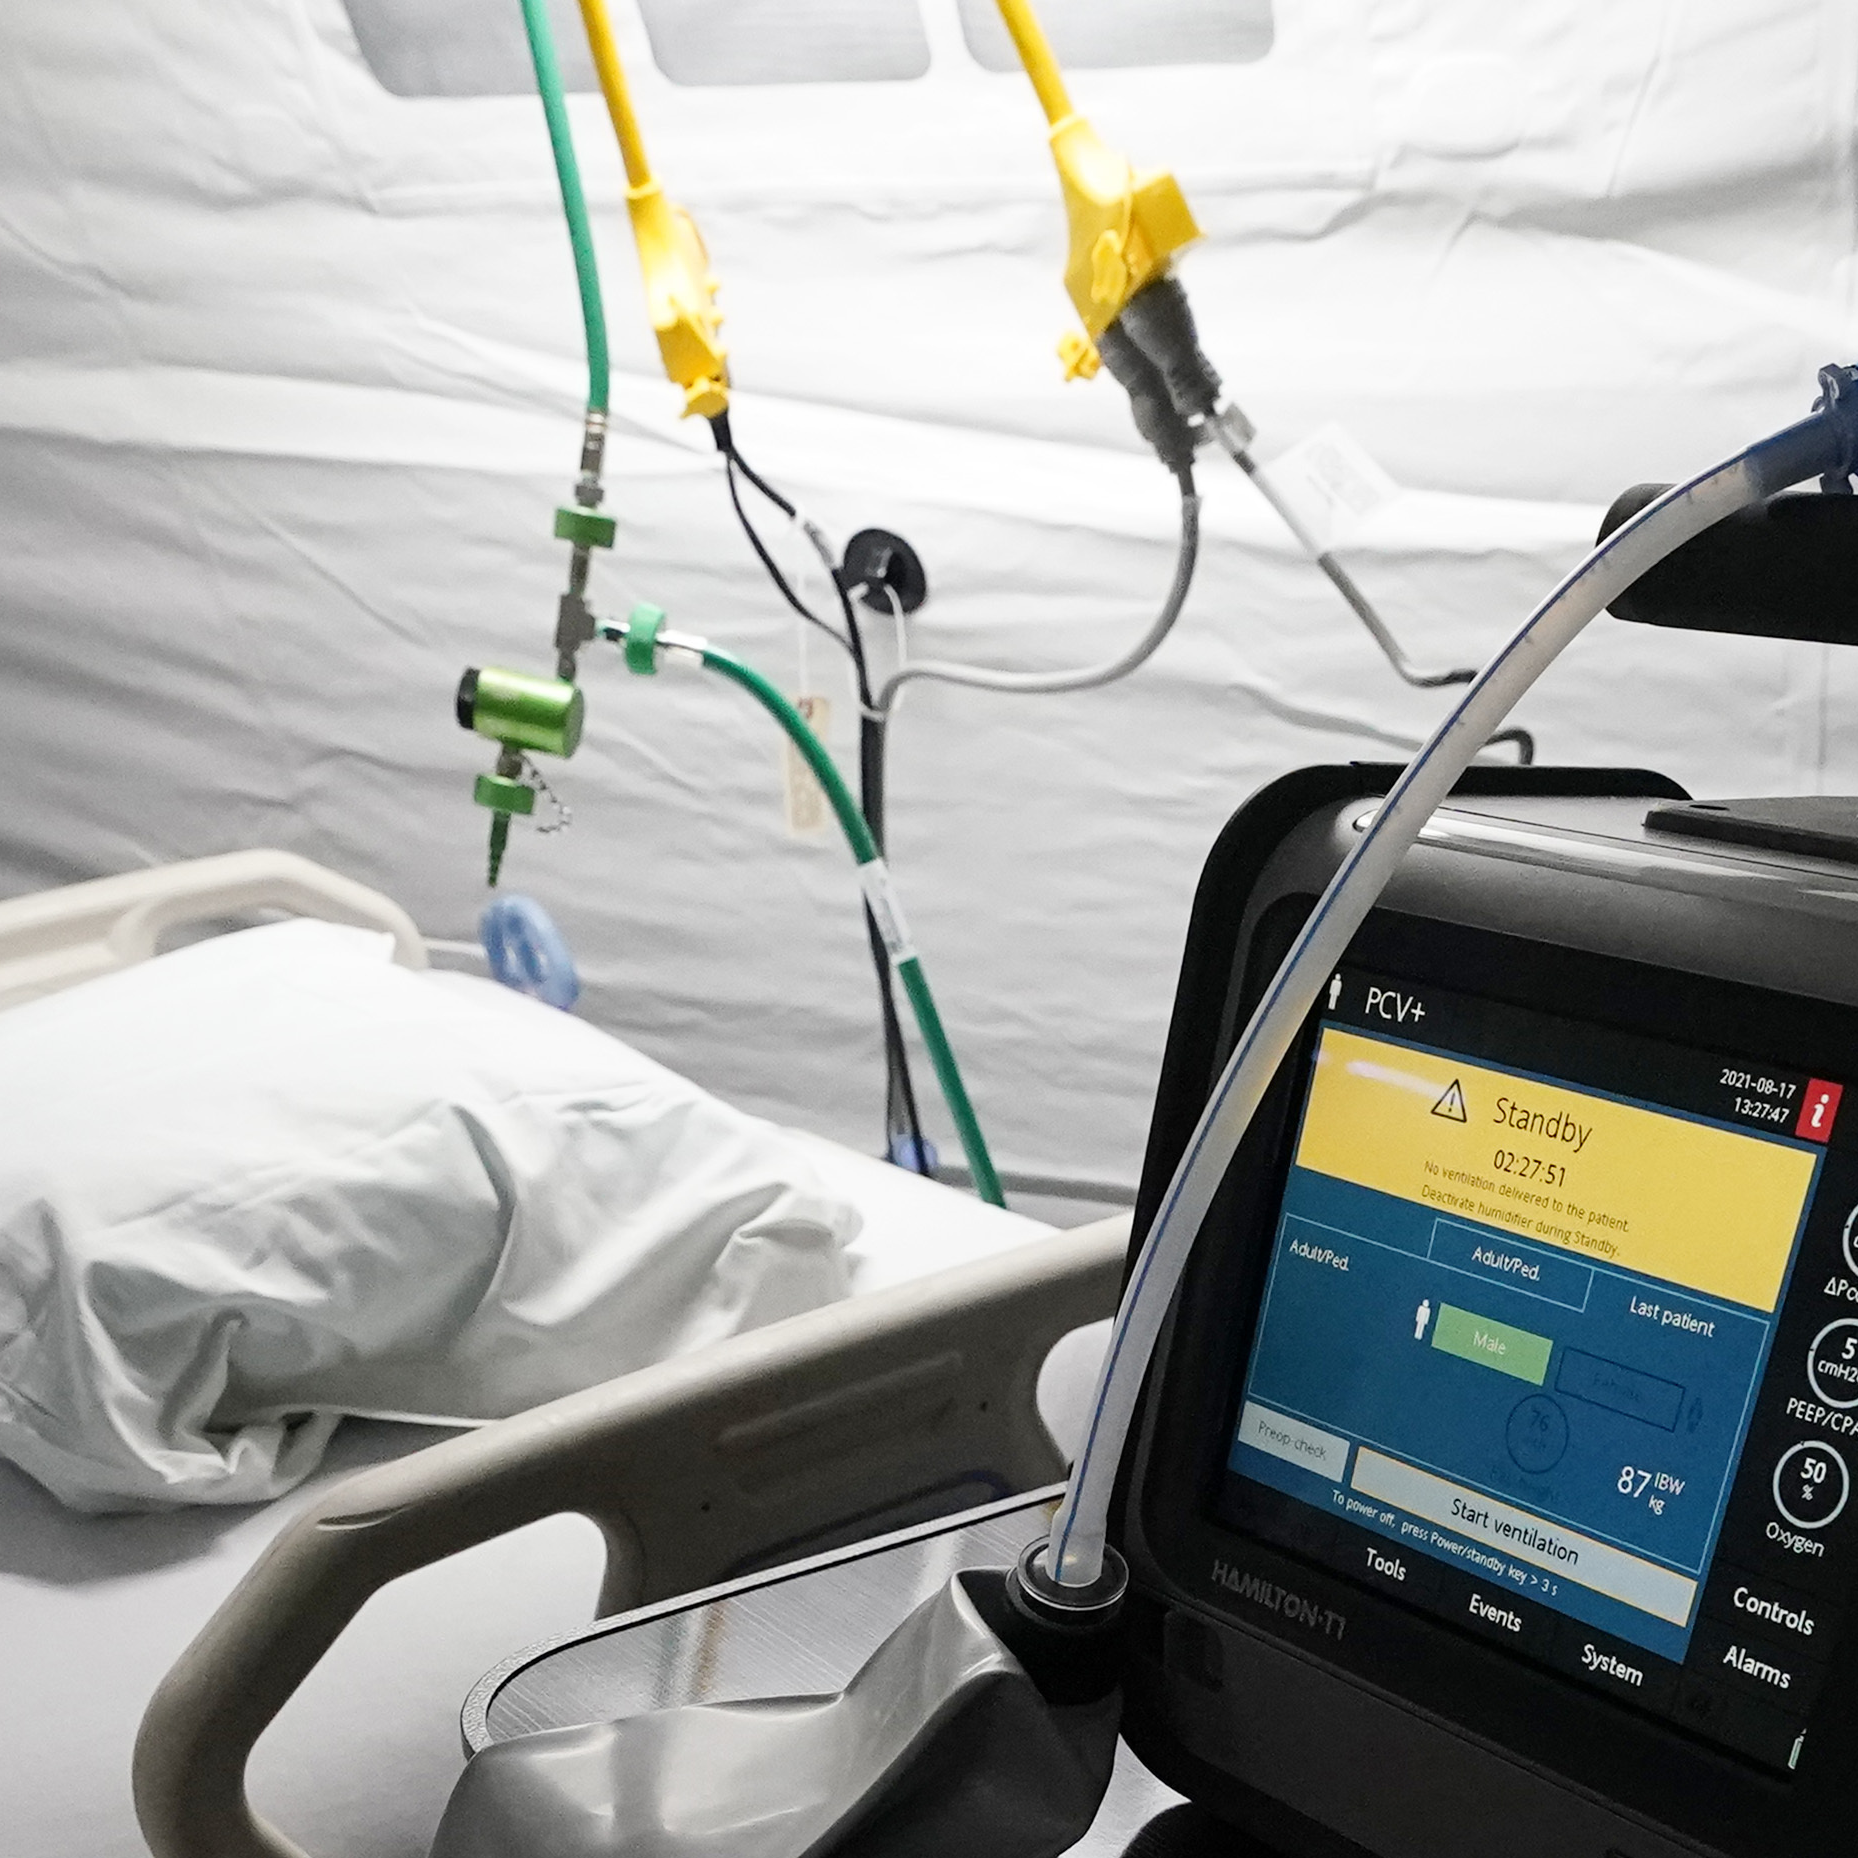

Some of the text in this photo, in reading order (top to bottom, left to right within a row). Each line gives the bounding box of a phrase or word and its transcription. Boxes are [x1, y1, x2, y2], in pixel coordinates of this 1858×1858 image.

[1364, 986, 1426, 1022] PCV+
[1720, 1068, 1797, 1099] 2021-08-17
[1493, 1097, 1593, 1153] Standby
[1735, 1096, 1790, 1124] 13:27:47
[1493, 1149, 1566, 1187] 02:27:51
[1424, 1160, 1439, 1175] No
[1442, 1167, 1495, 1193] ventilation
[1499, 1183, 1549, 1209] delivered
[1552, 1199, 1563, 1213] to
[1566, 1203, 1585, 1220] the
[1421, 1184, 1621, 1260] Deactivate humidifier during Standby.
[1289, 1238, 1349, 1271] Adult/Ped.
[1471, 1246, 1541, 1281] Adult/Ped.
[1629, 1295, 1716, 1338] Last patient
[1473, 1331, 1506, 1356] Male
[1841, 1337, 1858, 1360] 5
[1258, 1420, 1327, 1461] Preop check
[1617, 1465, 1686, 1499] 87 IBW
[1800, 1457, 1827, 1484] 50
[1648, 1494, 1666, 1516] kg
[1801, 1484, 1814, 1501] %
[1332, 1489, 1344, 1504] To
[1346, 1496, 1378, 1519] power
[1379, 1511, 1396, 1529] off,
[1400, 1520, 1429, 1541] press
[1430, 1532, 1506, 1578] Power/standby
[1508, 1564, 1527, 1586] key
[1541, 1578, 1550, 1593] 3
[1450, 1498, 1579, 1566] Start ventilation
[1765, 1521, 1825, 1558] Oxygen
[1366, 1547, 1407, 1582] Tools
[1468, 1593, 1522, 1632] Events
[1733, 1586, 1815, 1636] Controls
[1581, 1643, 1644, 1687] System
[1723, 1645, 1791, 1689] Alarms
